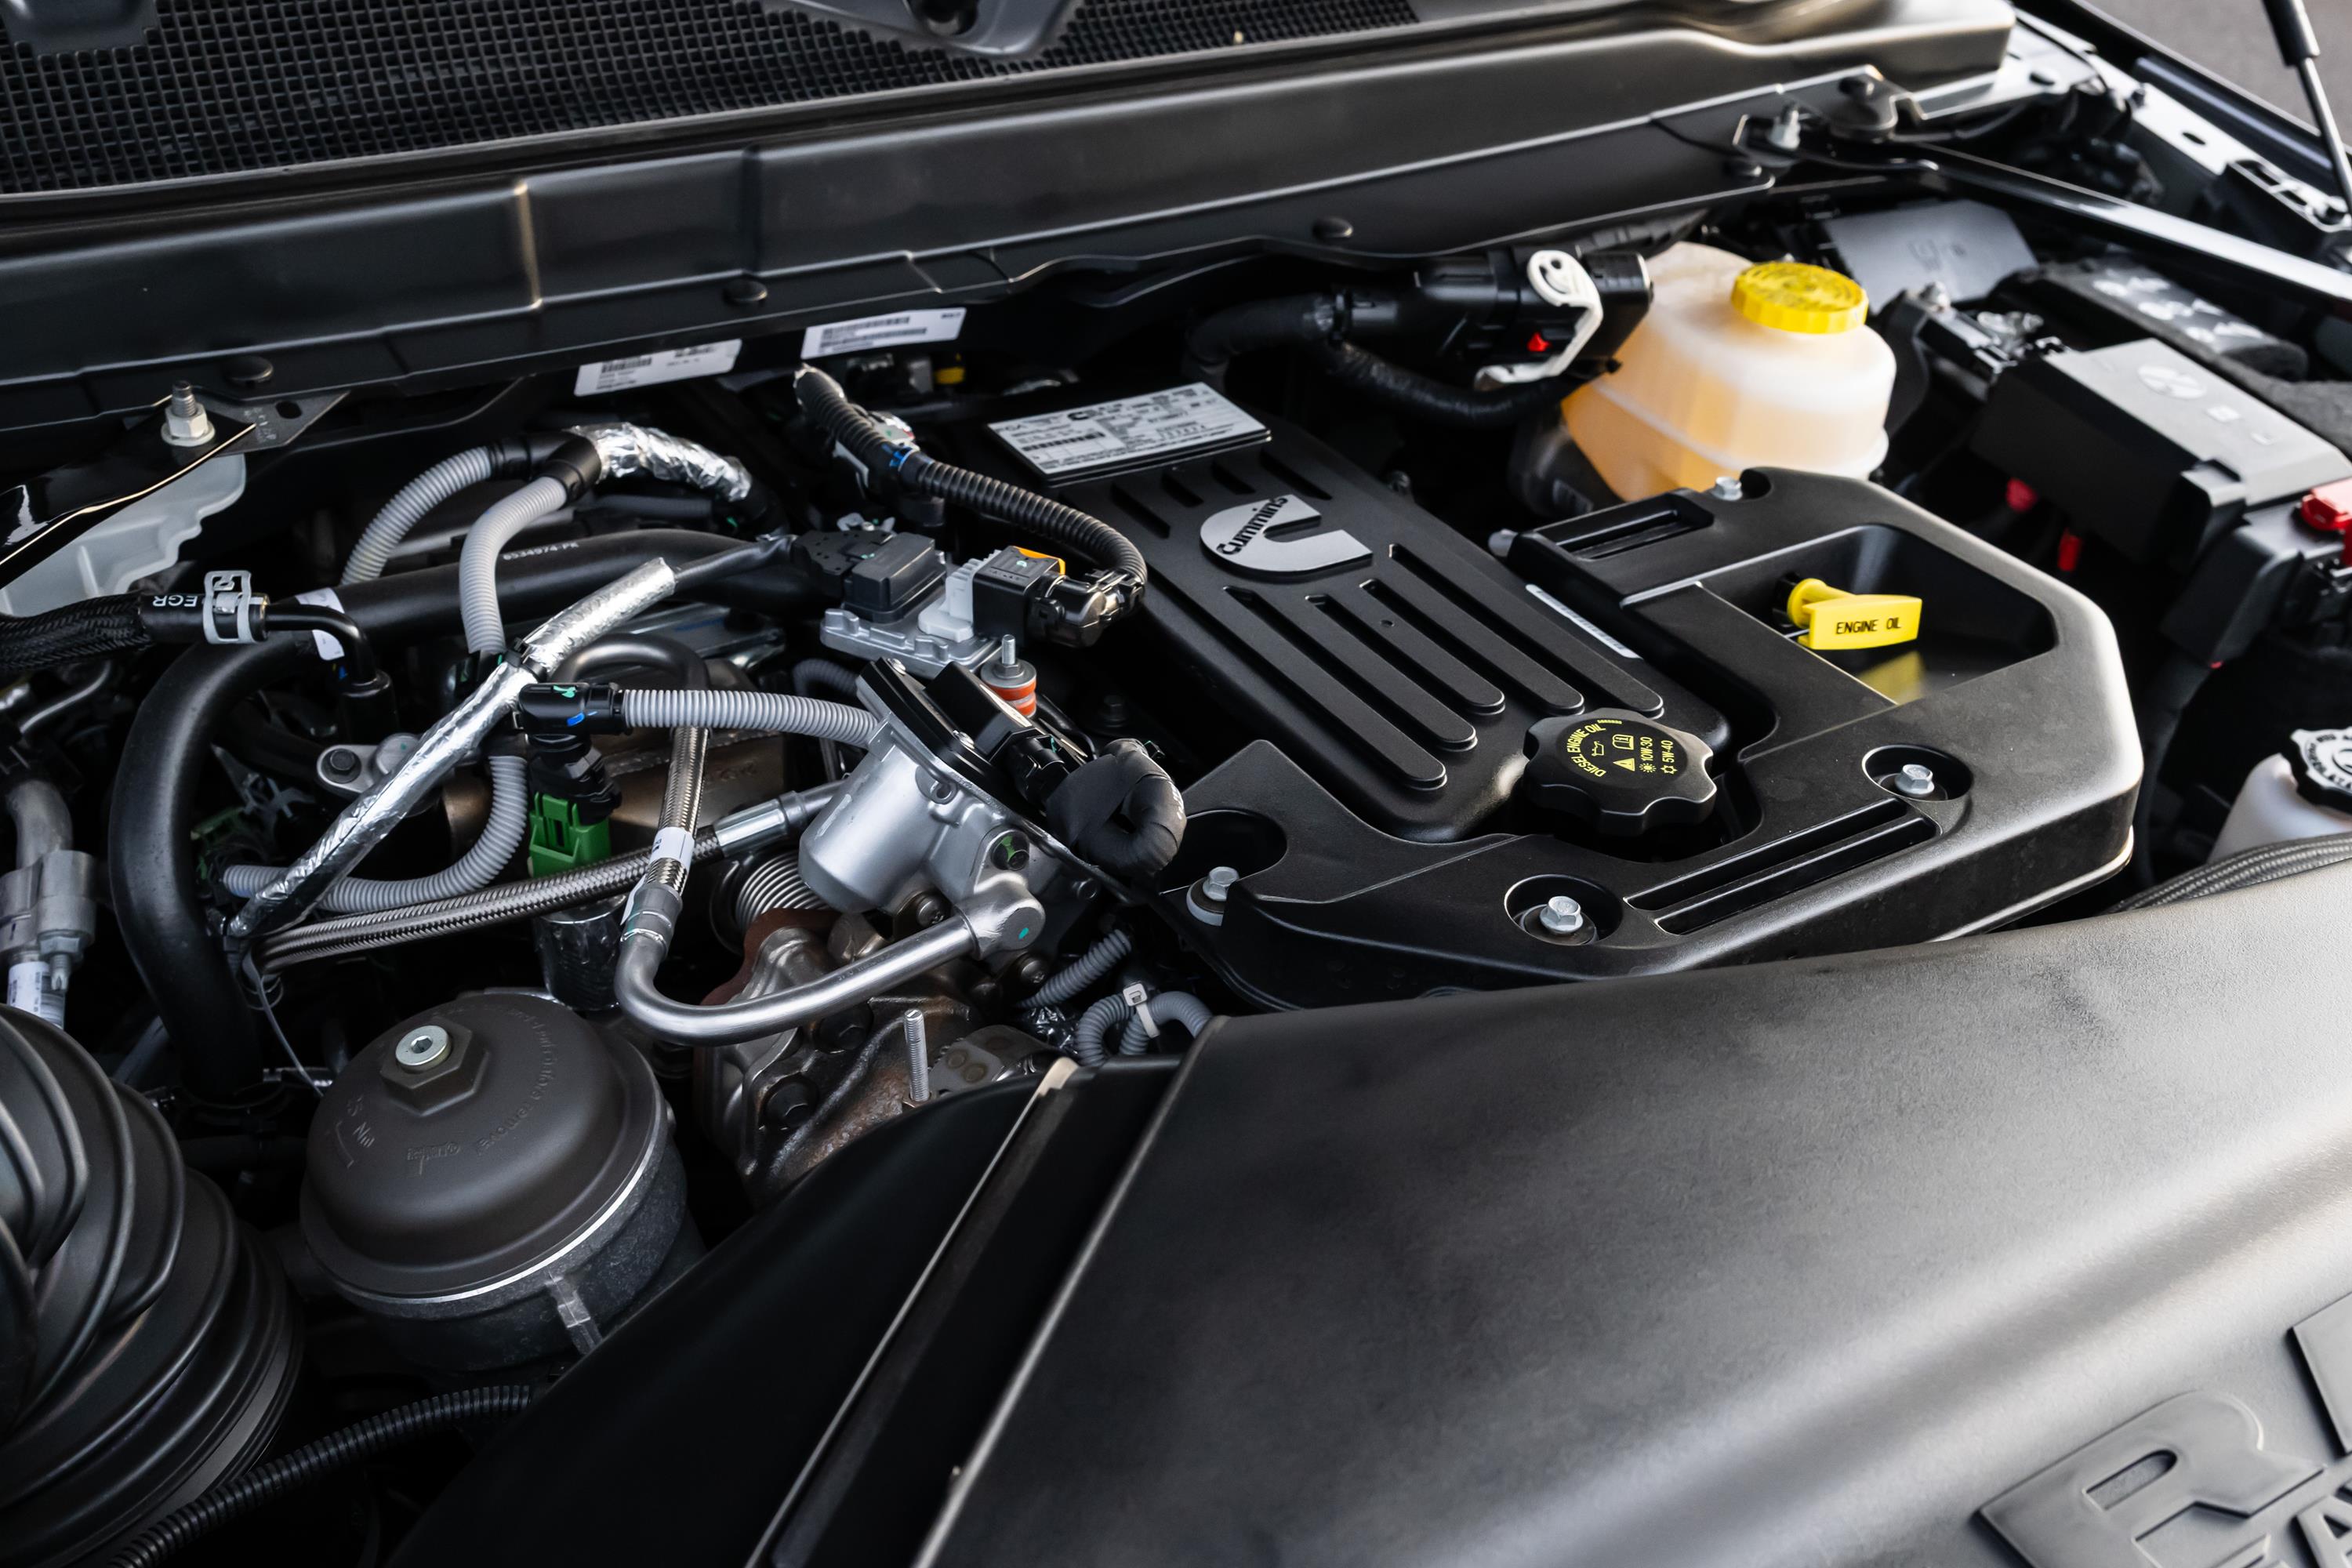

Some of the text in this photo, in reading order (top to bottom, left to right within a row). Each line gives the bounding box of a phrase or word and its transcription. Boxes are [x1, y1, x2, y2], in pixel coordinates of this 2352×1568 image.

[1216, 497, 1288, 555] Cummins
[153, 595, 198, 607] EGR
[1835, 617, 1901, 634] ENGINE OIL
[1566, 723, 1606, 777] DIESEL ENGINE OIL
[1640, 736, 1653, 761] 10W-30
[1661, 740, 1675, 763] 5W-40
